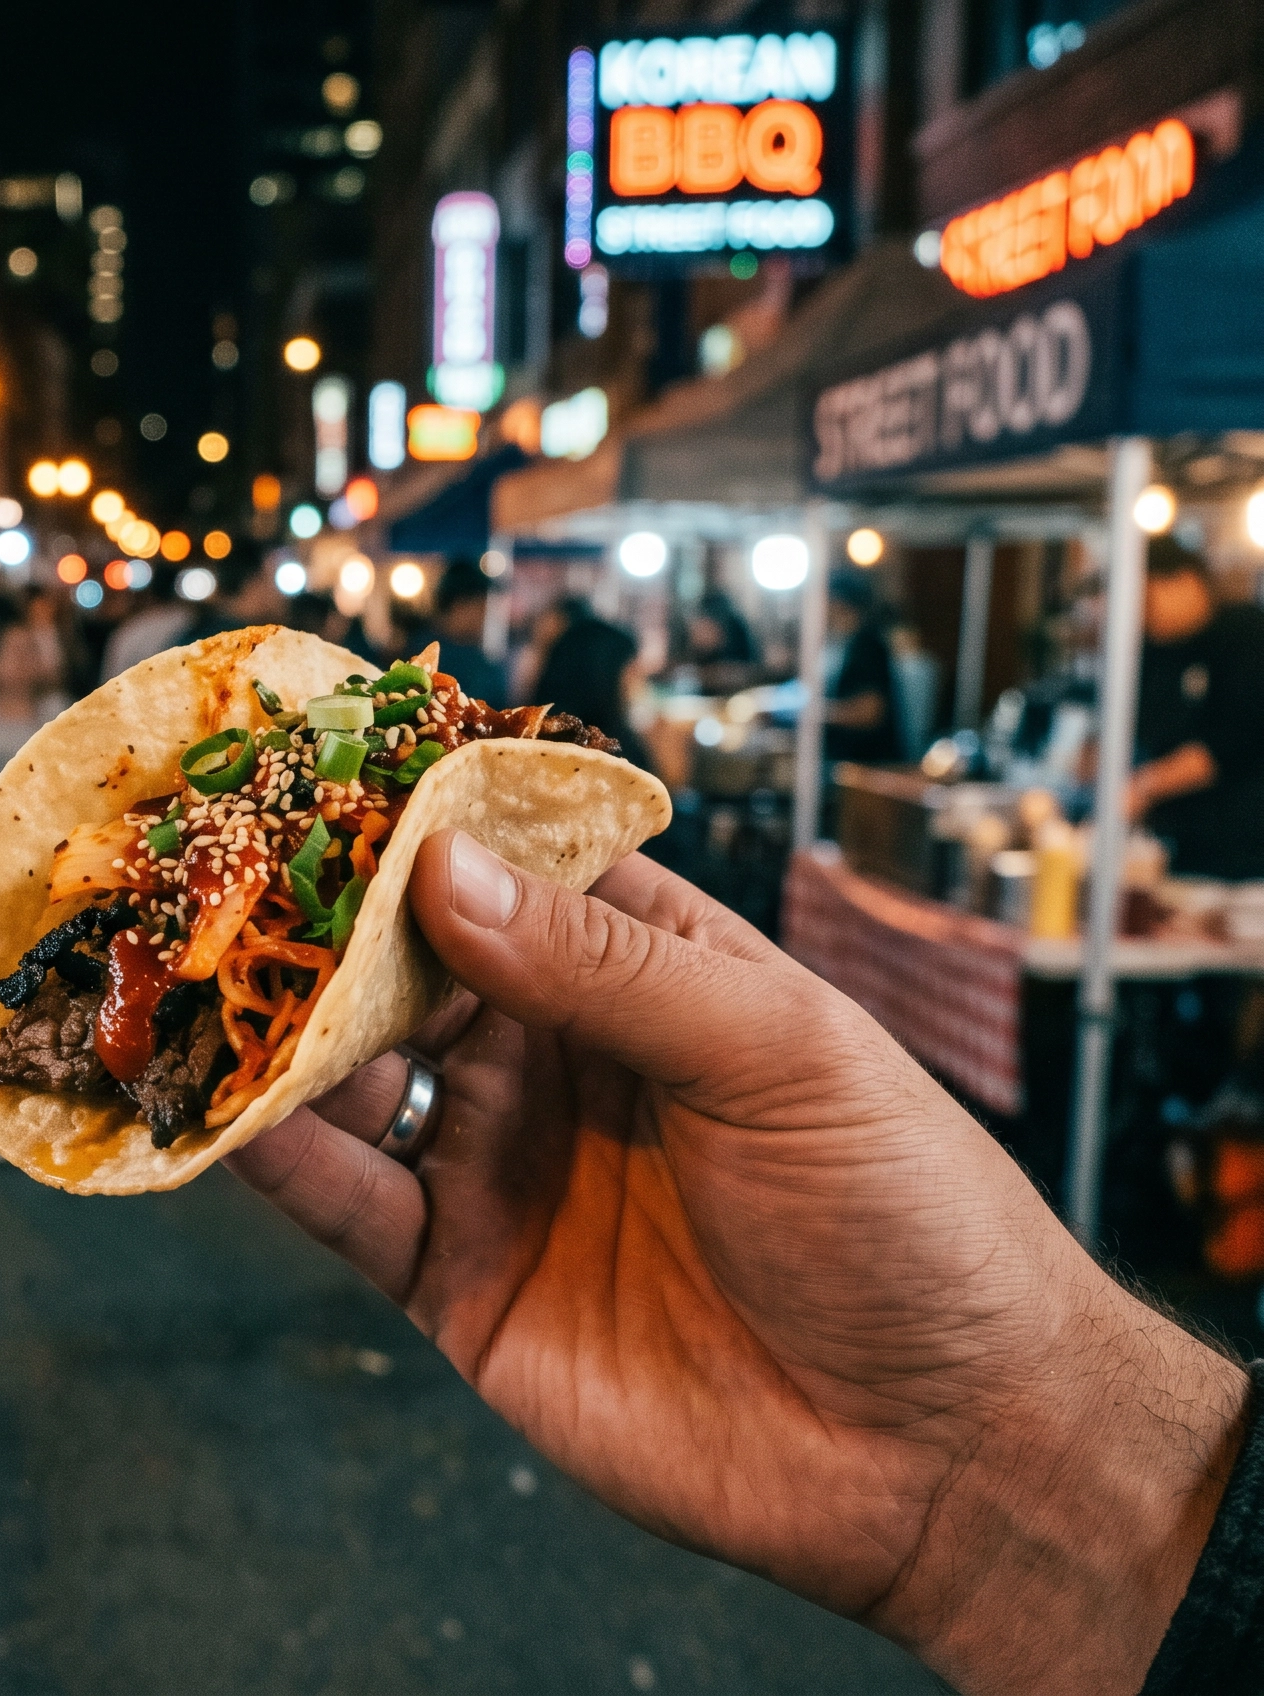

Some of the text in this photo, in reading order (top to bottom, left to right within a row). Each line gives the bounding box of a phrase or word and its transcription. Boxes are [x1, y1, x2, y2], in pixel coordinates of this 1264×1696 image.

[599, 31, 836, 110] KOREAN
[609, 98, 823, 197] BBQ
[940, 118, 1194, 298] STREET FOOD
[814, 302, 1091, 481] STREET FOOD
